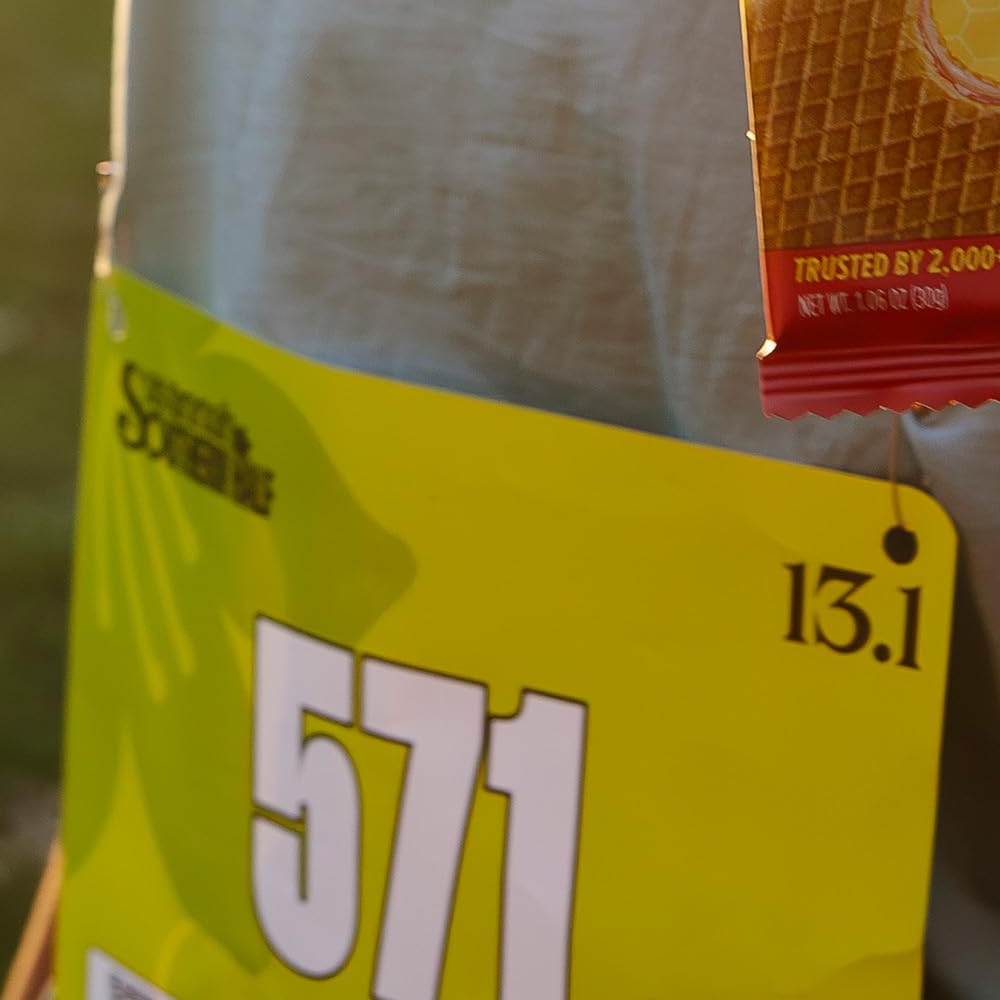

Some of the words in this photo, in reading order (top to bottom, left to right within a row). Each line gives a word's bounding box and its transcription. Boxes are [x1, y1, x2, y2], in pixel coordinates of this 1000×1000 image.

[794, 252, 888, 282] TRUSTED
[894, 250, 923, 277] BY
[783, 562, 922, 671] 13.1
[250, 612, 590, 1000] 571
